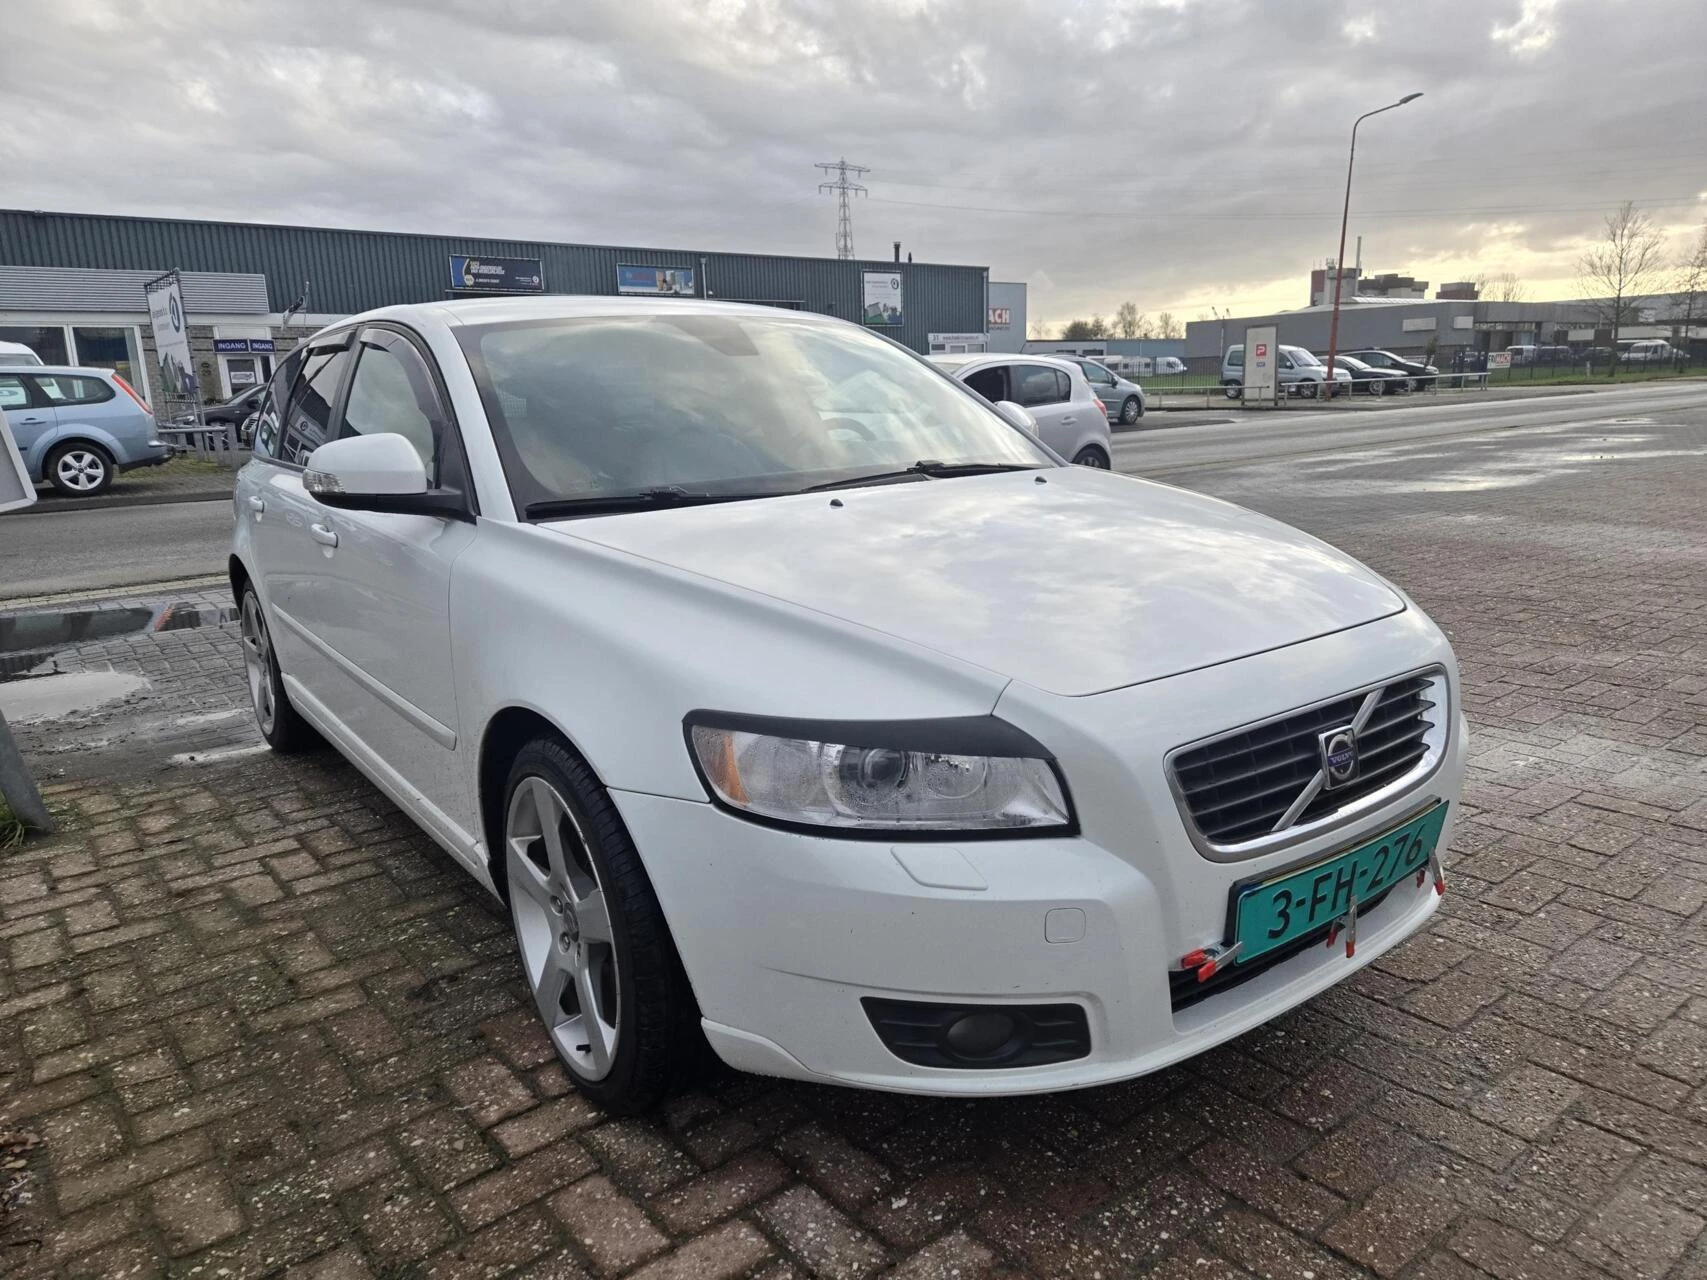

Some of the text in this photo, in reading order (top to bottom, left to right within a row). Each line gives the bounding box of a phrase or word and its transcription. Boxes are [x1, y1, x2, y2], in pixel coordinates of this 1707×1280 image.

[217, 342, 246, 350] INGANG
[252, 342, 273, 350] INGANG
[1268, 823, 1426, 940] 3-FH-276
